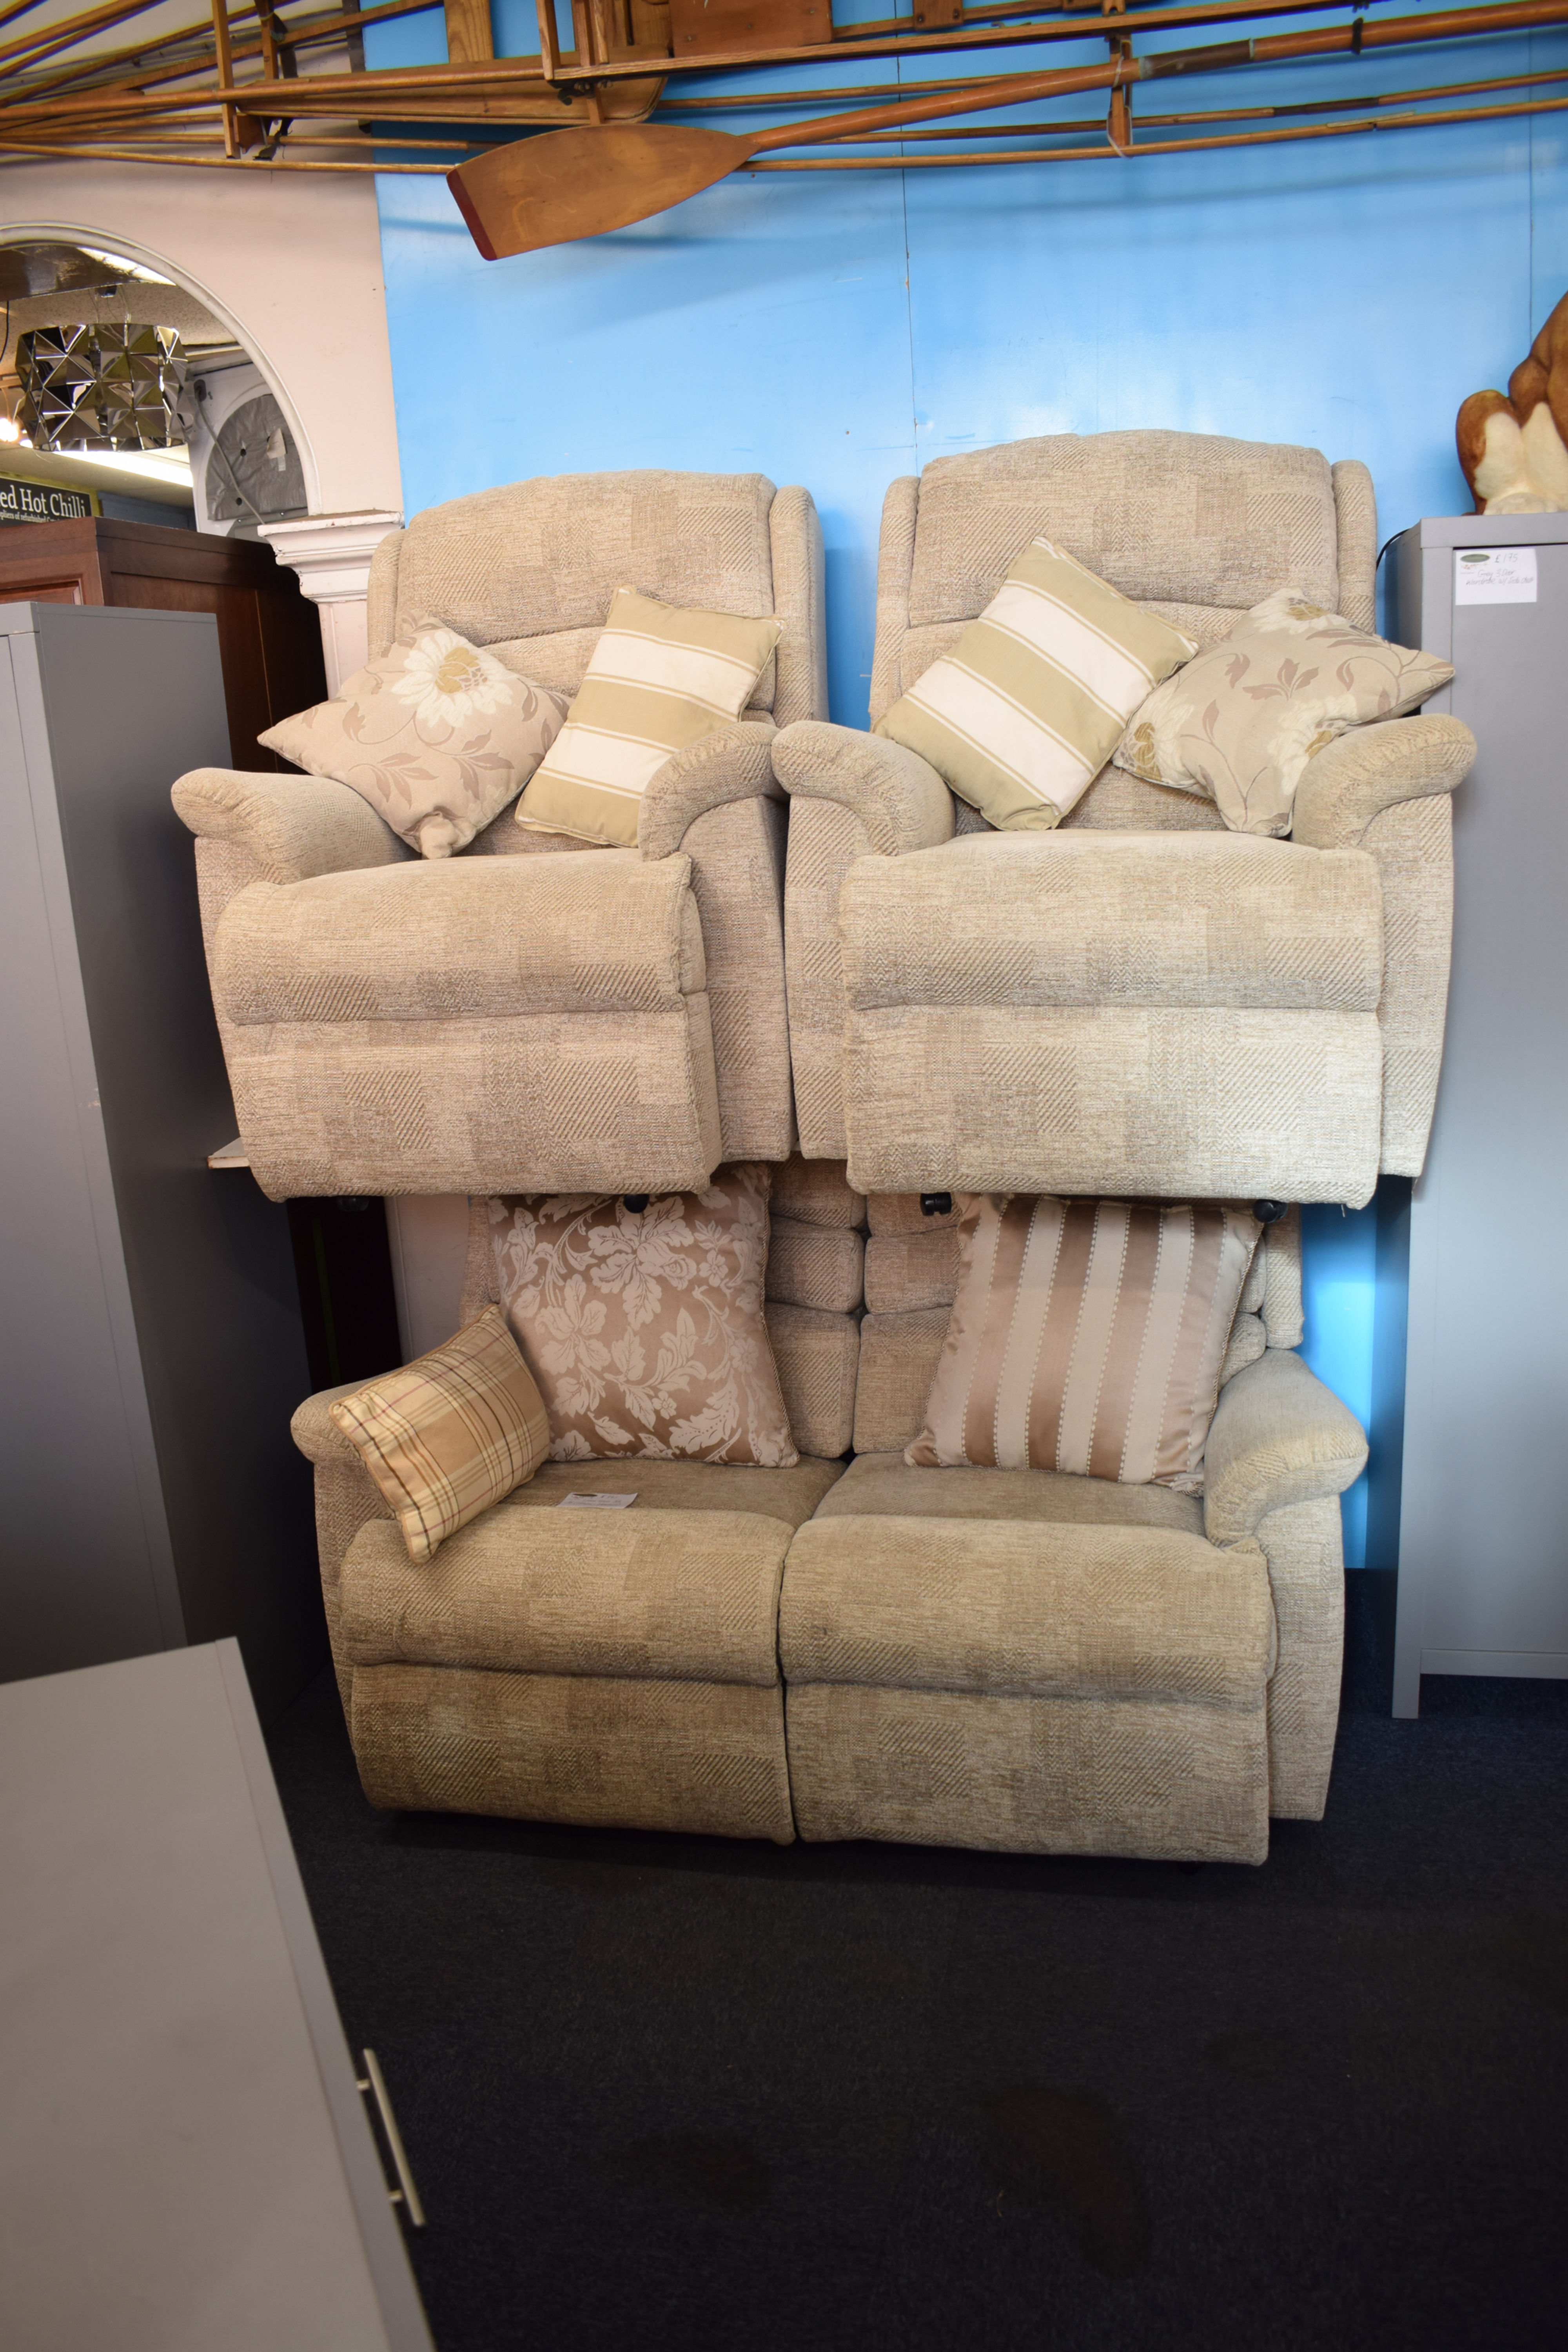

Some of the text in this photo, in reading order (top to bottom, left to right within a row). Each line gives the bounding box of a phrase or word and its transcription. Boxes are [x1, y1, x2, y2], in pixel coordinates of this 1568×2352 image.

[0, 485, 85, 518] ed Hot Chilli
[1495, 553, 1518, 563] £175
[1477, 570, 1493, 580] Grey
